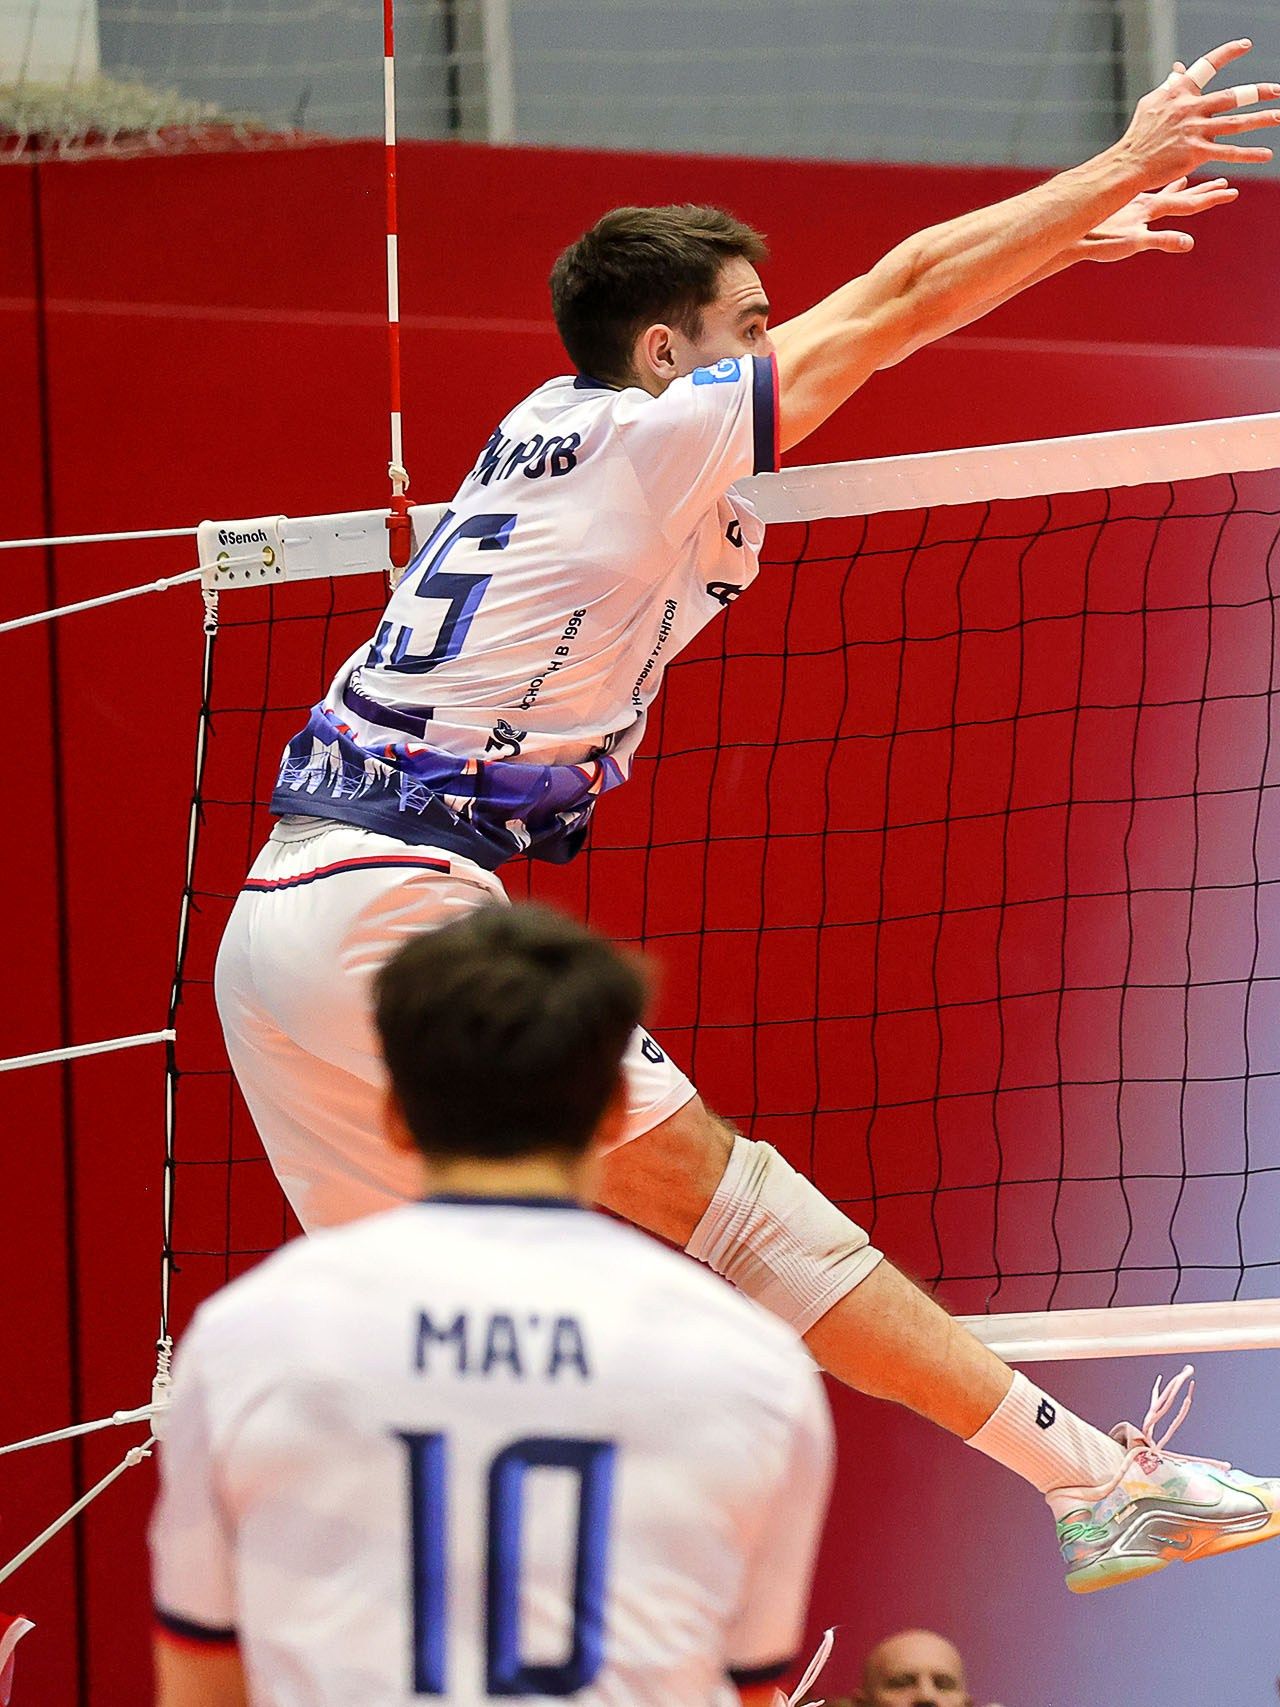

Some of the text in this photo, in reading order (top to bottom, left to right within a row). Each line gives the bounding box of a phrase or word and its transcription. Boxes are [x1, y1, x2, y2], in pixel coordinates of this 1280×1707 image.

[228, 528, 268, 545] Senoh
[519, 608, 588, 711] ОСНОН В 1996
[412, 1306, 594, 1381] MA'A
[390, 1429, 621, 1698] 10
